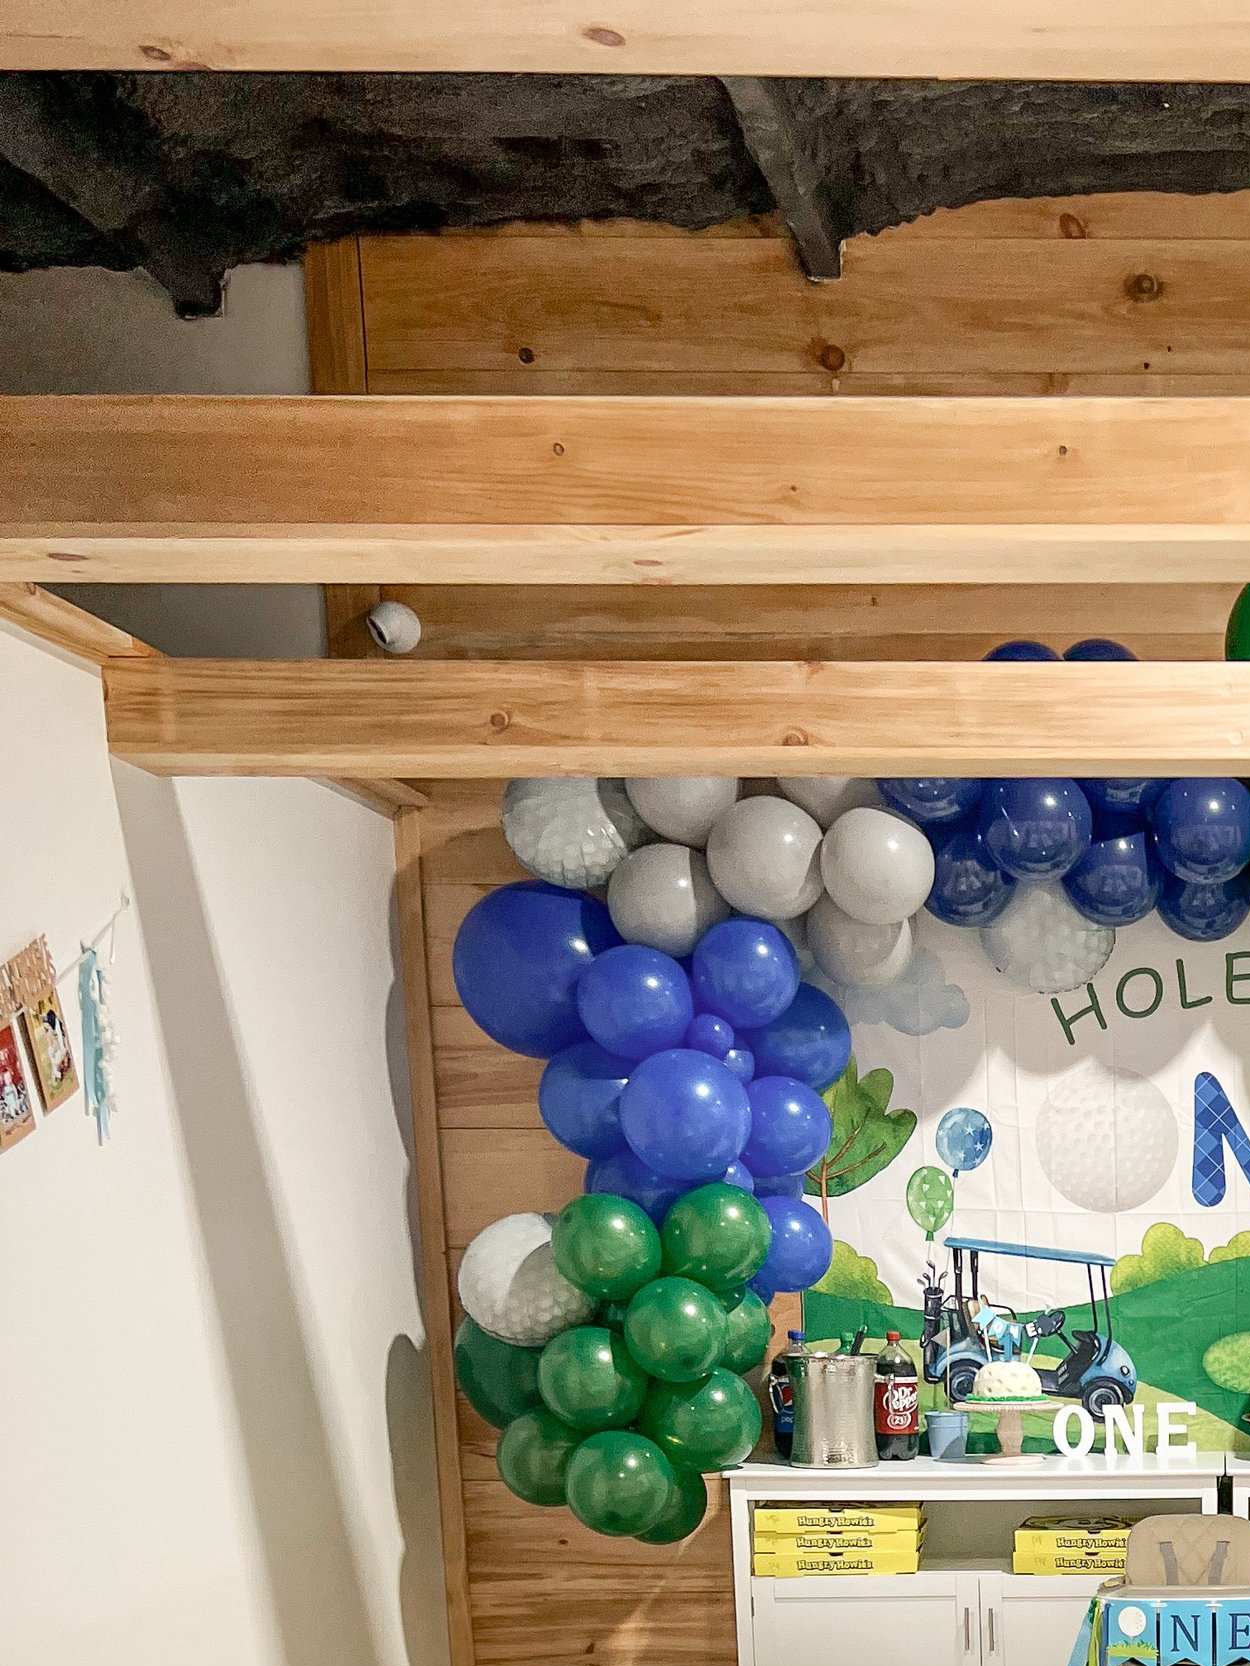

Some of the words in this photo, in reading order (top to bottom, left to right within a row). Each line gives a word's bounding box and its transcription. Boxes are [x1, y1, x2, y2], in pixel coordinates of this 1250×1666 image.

[1053, 1402, 1198, 1459] ONE
[797, 1516, 838, 1528] Hungry
[796, 1537, 836, 1549] Hungry
[1056, 1537, 1095, 1549] Hungry
[797, 1560, 837, 1572] Hungry
[1055, 1557, 1094, 1569] Hungry
